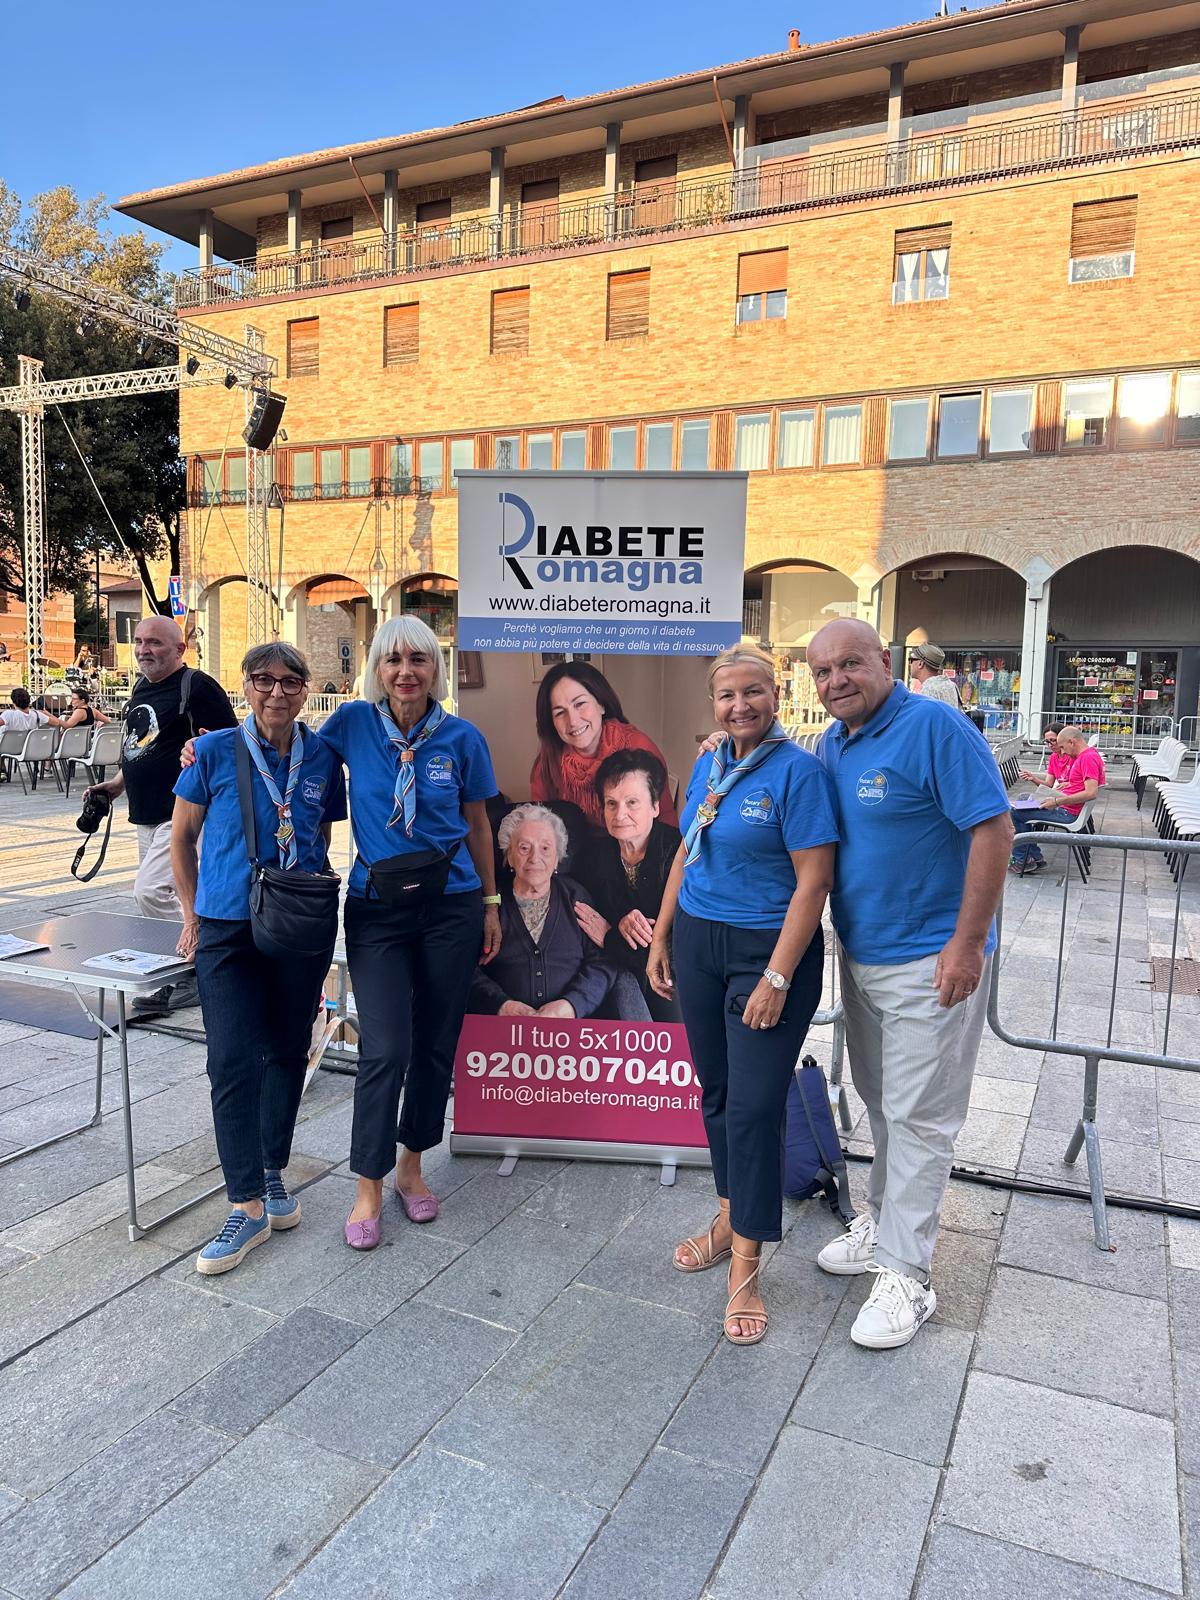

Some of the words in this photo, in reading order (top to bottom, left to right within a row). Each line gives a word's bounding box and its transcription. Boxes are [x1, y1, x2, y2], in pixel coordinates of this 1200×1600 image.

[499, 492, 704, 557] DIABETE
[502, 556, 703, 592] Romagna
[489, 594, 711, 618] www.diabeteromagna.it
[473, 637, 492, 647] non
[494, 637, 520, 648] abbia
[522, 637, 537, 650] più
[539, 638, 570, 650] potere
[572, 638, 582, 649] di
[584, 639, 625, 650] decidere
[628, 640, 650, 651] della
[653, 641, 669, 651] vita
[672, 641, 682, 651] di
[539, 623, 581, 637] vogliamo
[584, 625, 602, 635] che
[605, 626, 617, 635] un
[619, 626, 649, 638] giorno
[652, 626, 658, 636] il
[660, 626, 696, 637] diabete
[511, 1024, 523, 1046] Il
[531, 1027, 570, 1049] tuo
[579, 1028, 672, 1053] 5x1000
[466, 1051, 702, 1088] 9200807040
[481, 1084, 699, 1111] info@diabeteromagna.it
